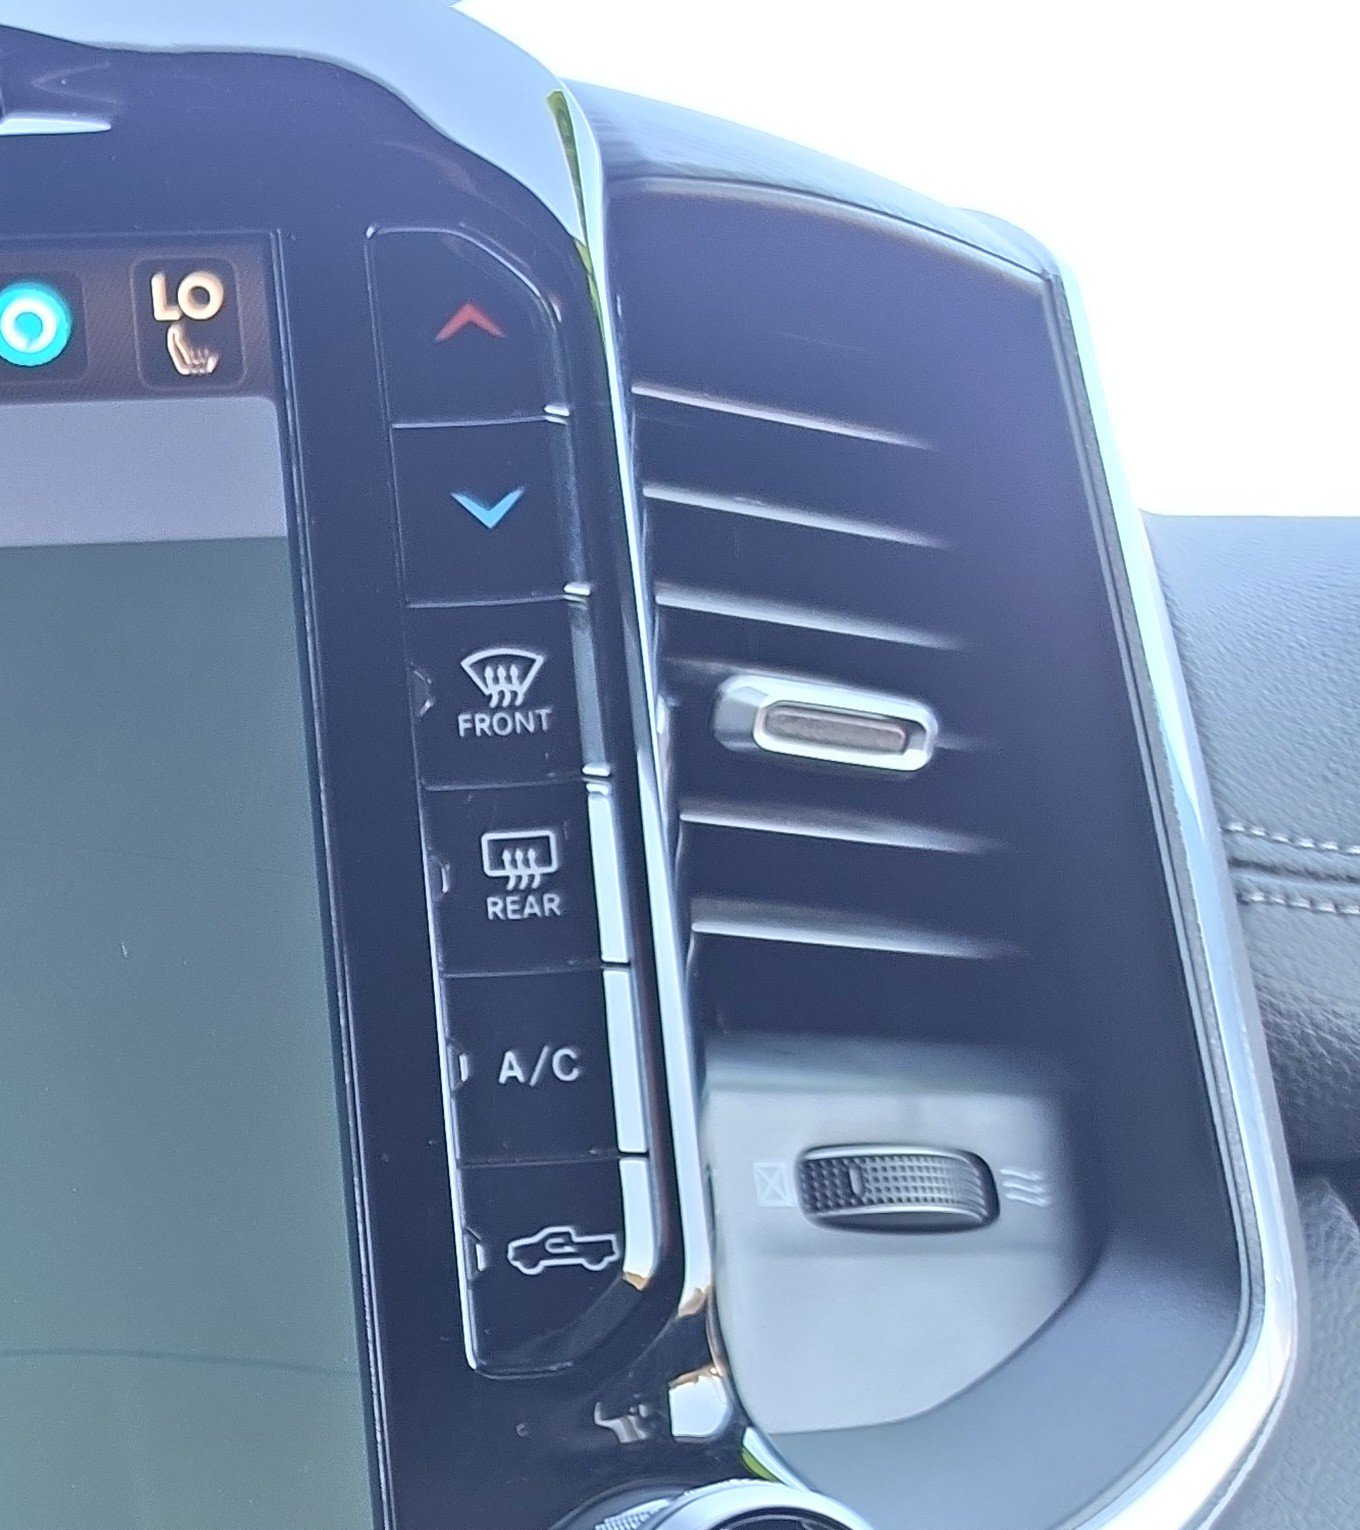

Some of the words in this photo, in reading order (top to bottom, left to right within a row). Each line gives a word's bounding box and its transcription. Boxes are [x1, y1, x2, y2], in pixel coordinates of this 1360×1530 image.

[152, 270, 225, 325] LO
[457, 707, 552, 737] FRONT
[486, 893, 561, 920] REAR
[498, 1046, 581, 1087] A/C
